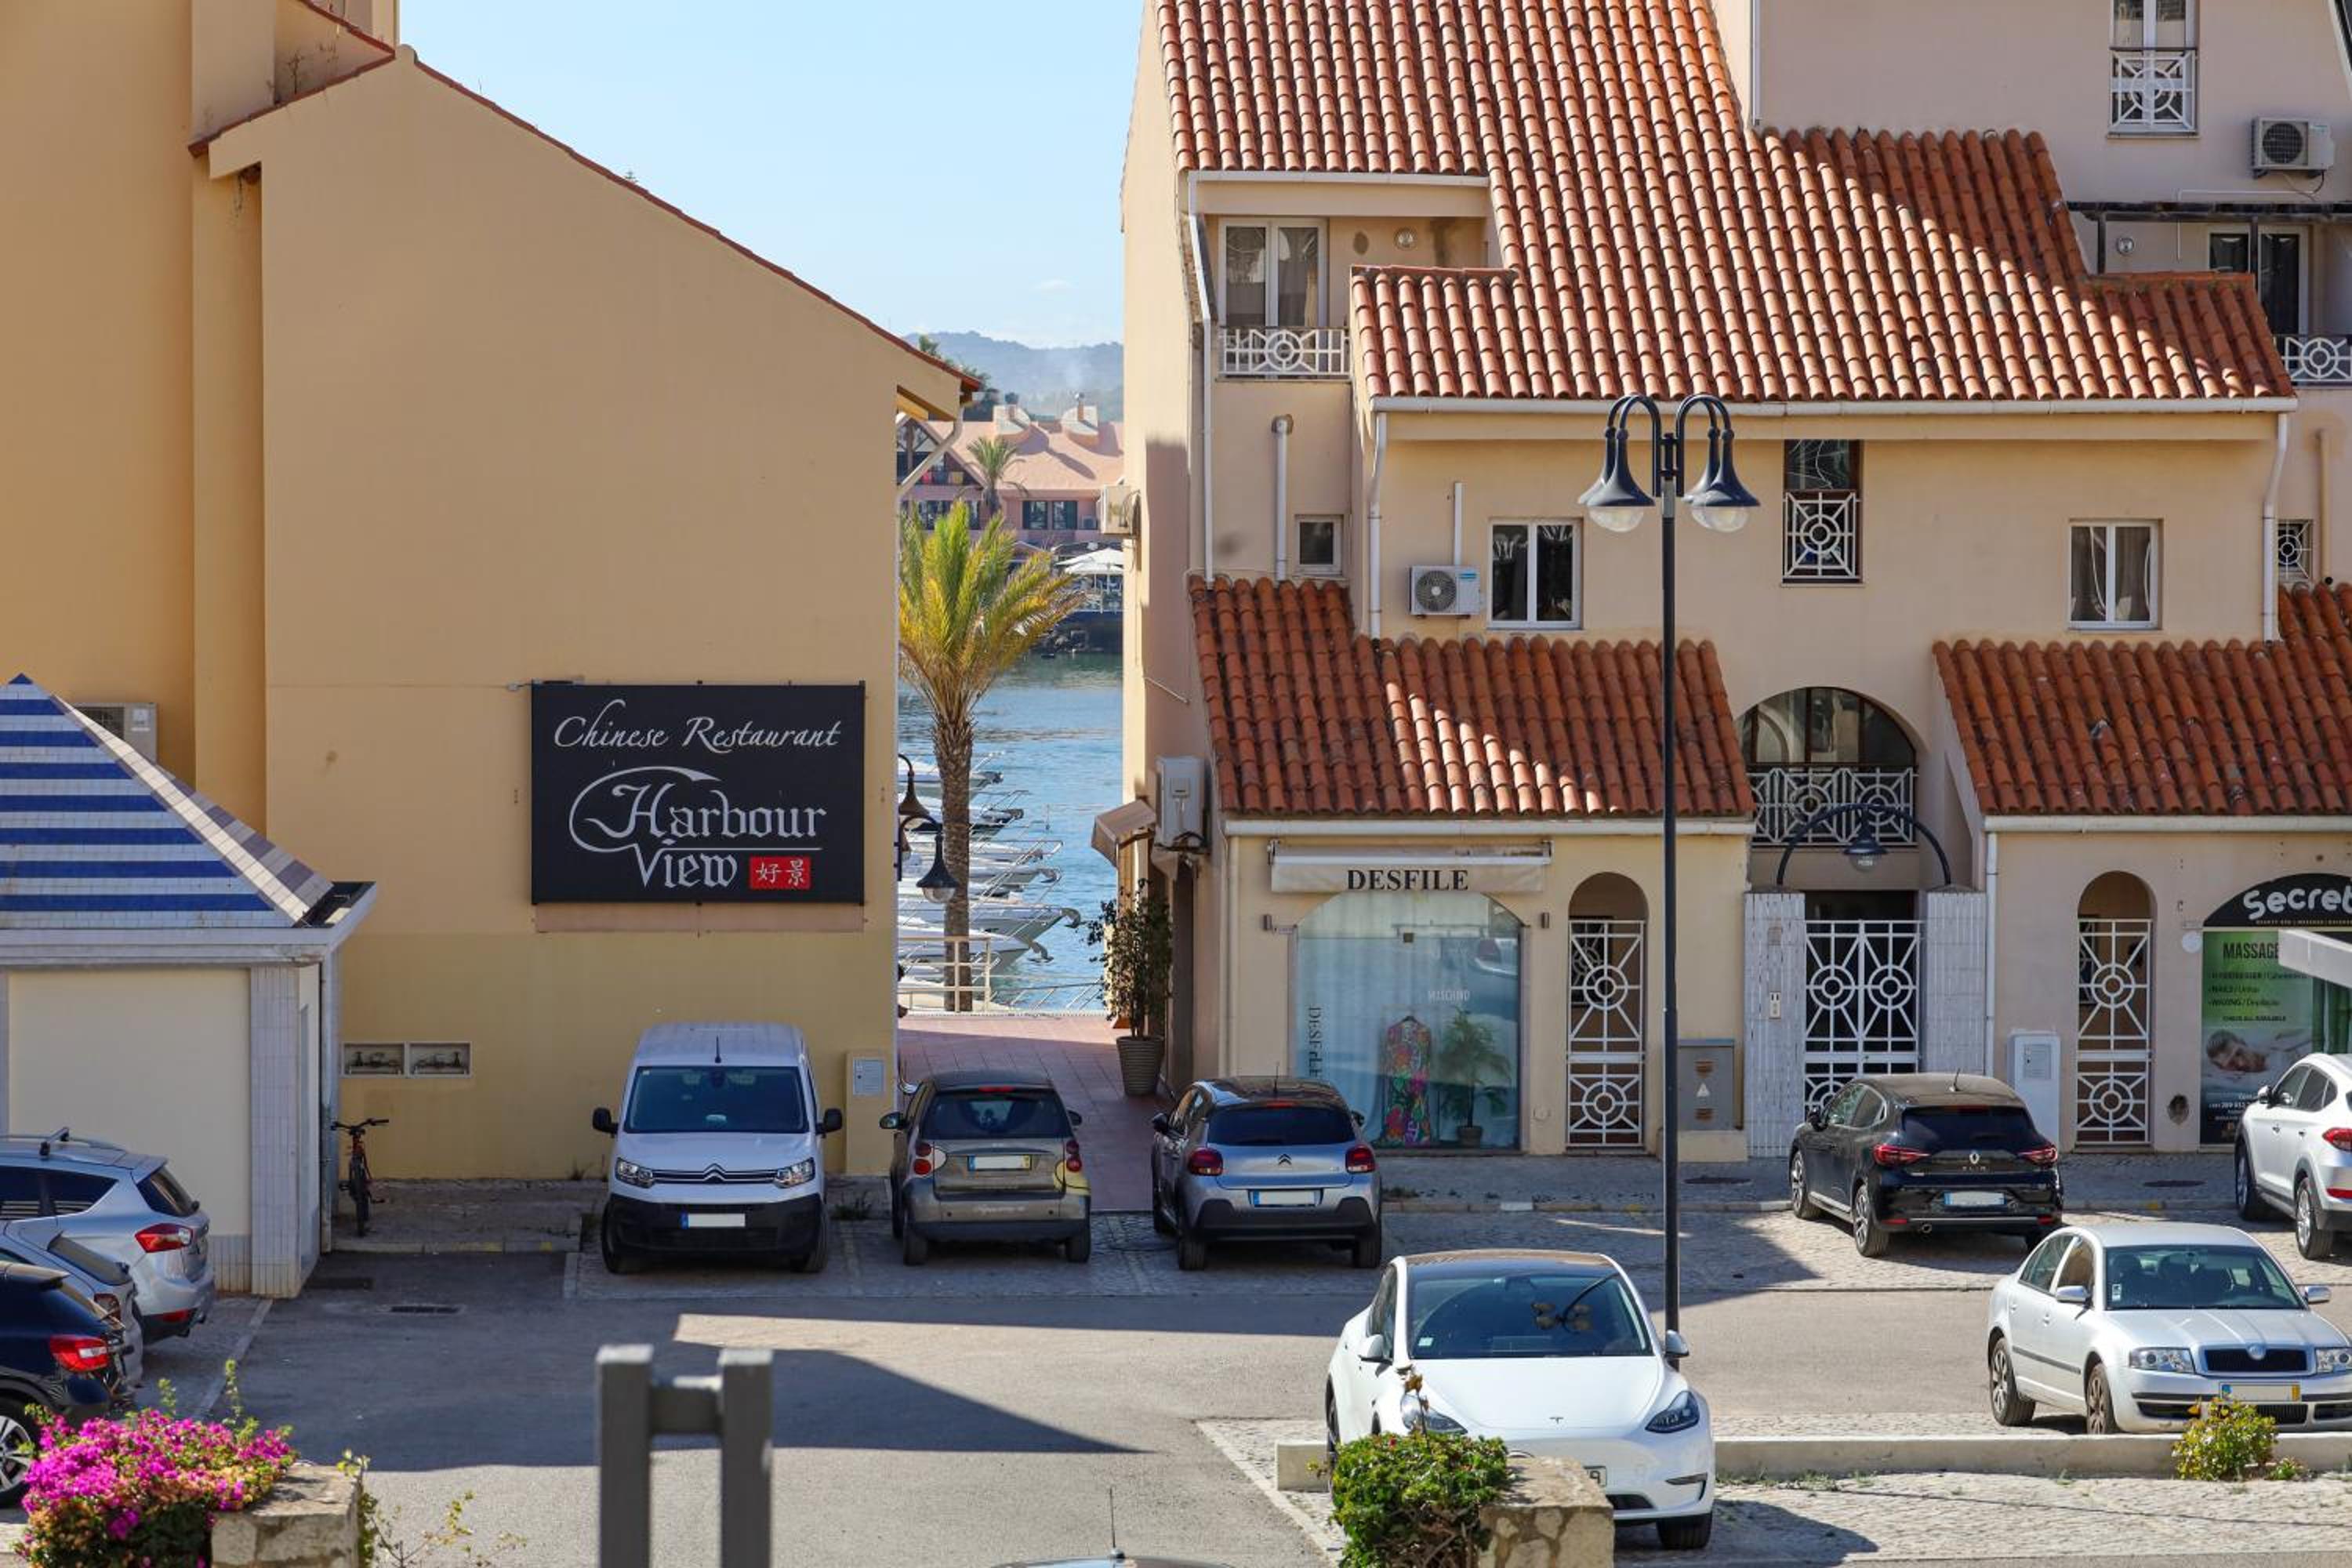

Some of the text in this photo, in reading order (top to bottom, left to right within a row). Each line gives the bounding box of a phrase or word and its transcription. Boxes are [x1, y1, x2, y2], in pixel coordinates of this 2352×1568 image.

[554, 699, 841, 754] Chinese Restaurant
[584, 782, 827, 839] Harbour
[633, 841, 739, 888] View
[755, 859, 808, 887] 好景
[1347, 869, 1469, 891] DESFILE
[1308, 1007, 1323, 1078] DESFILE
